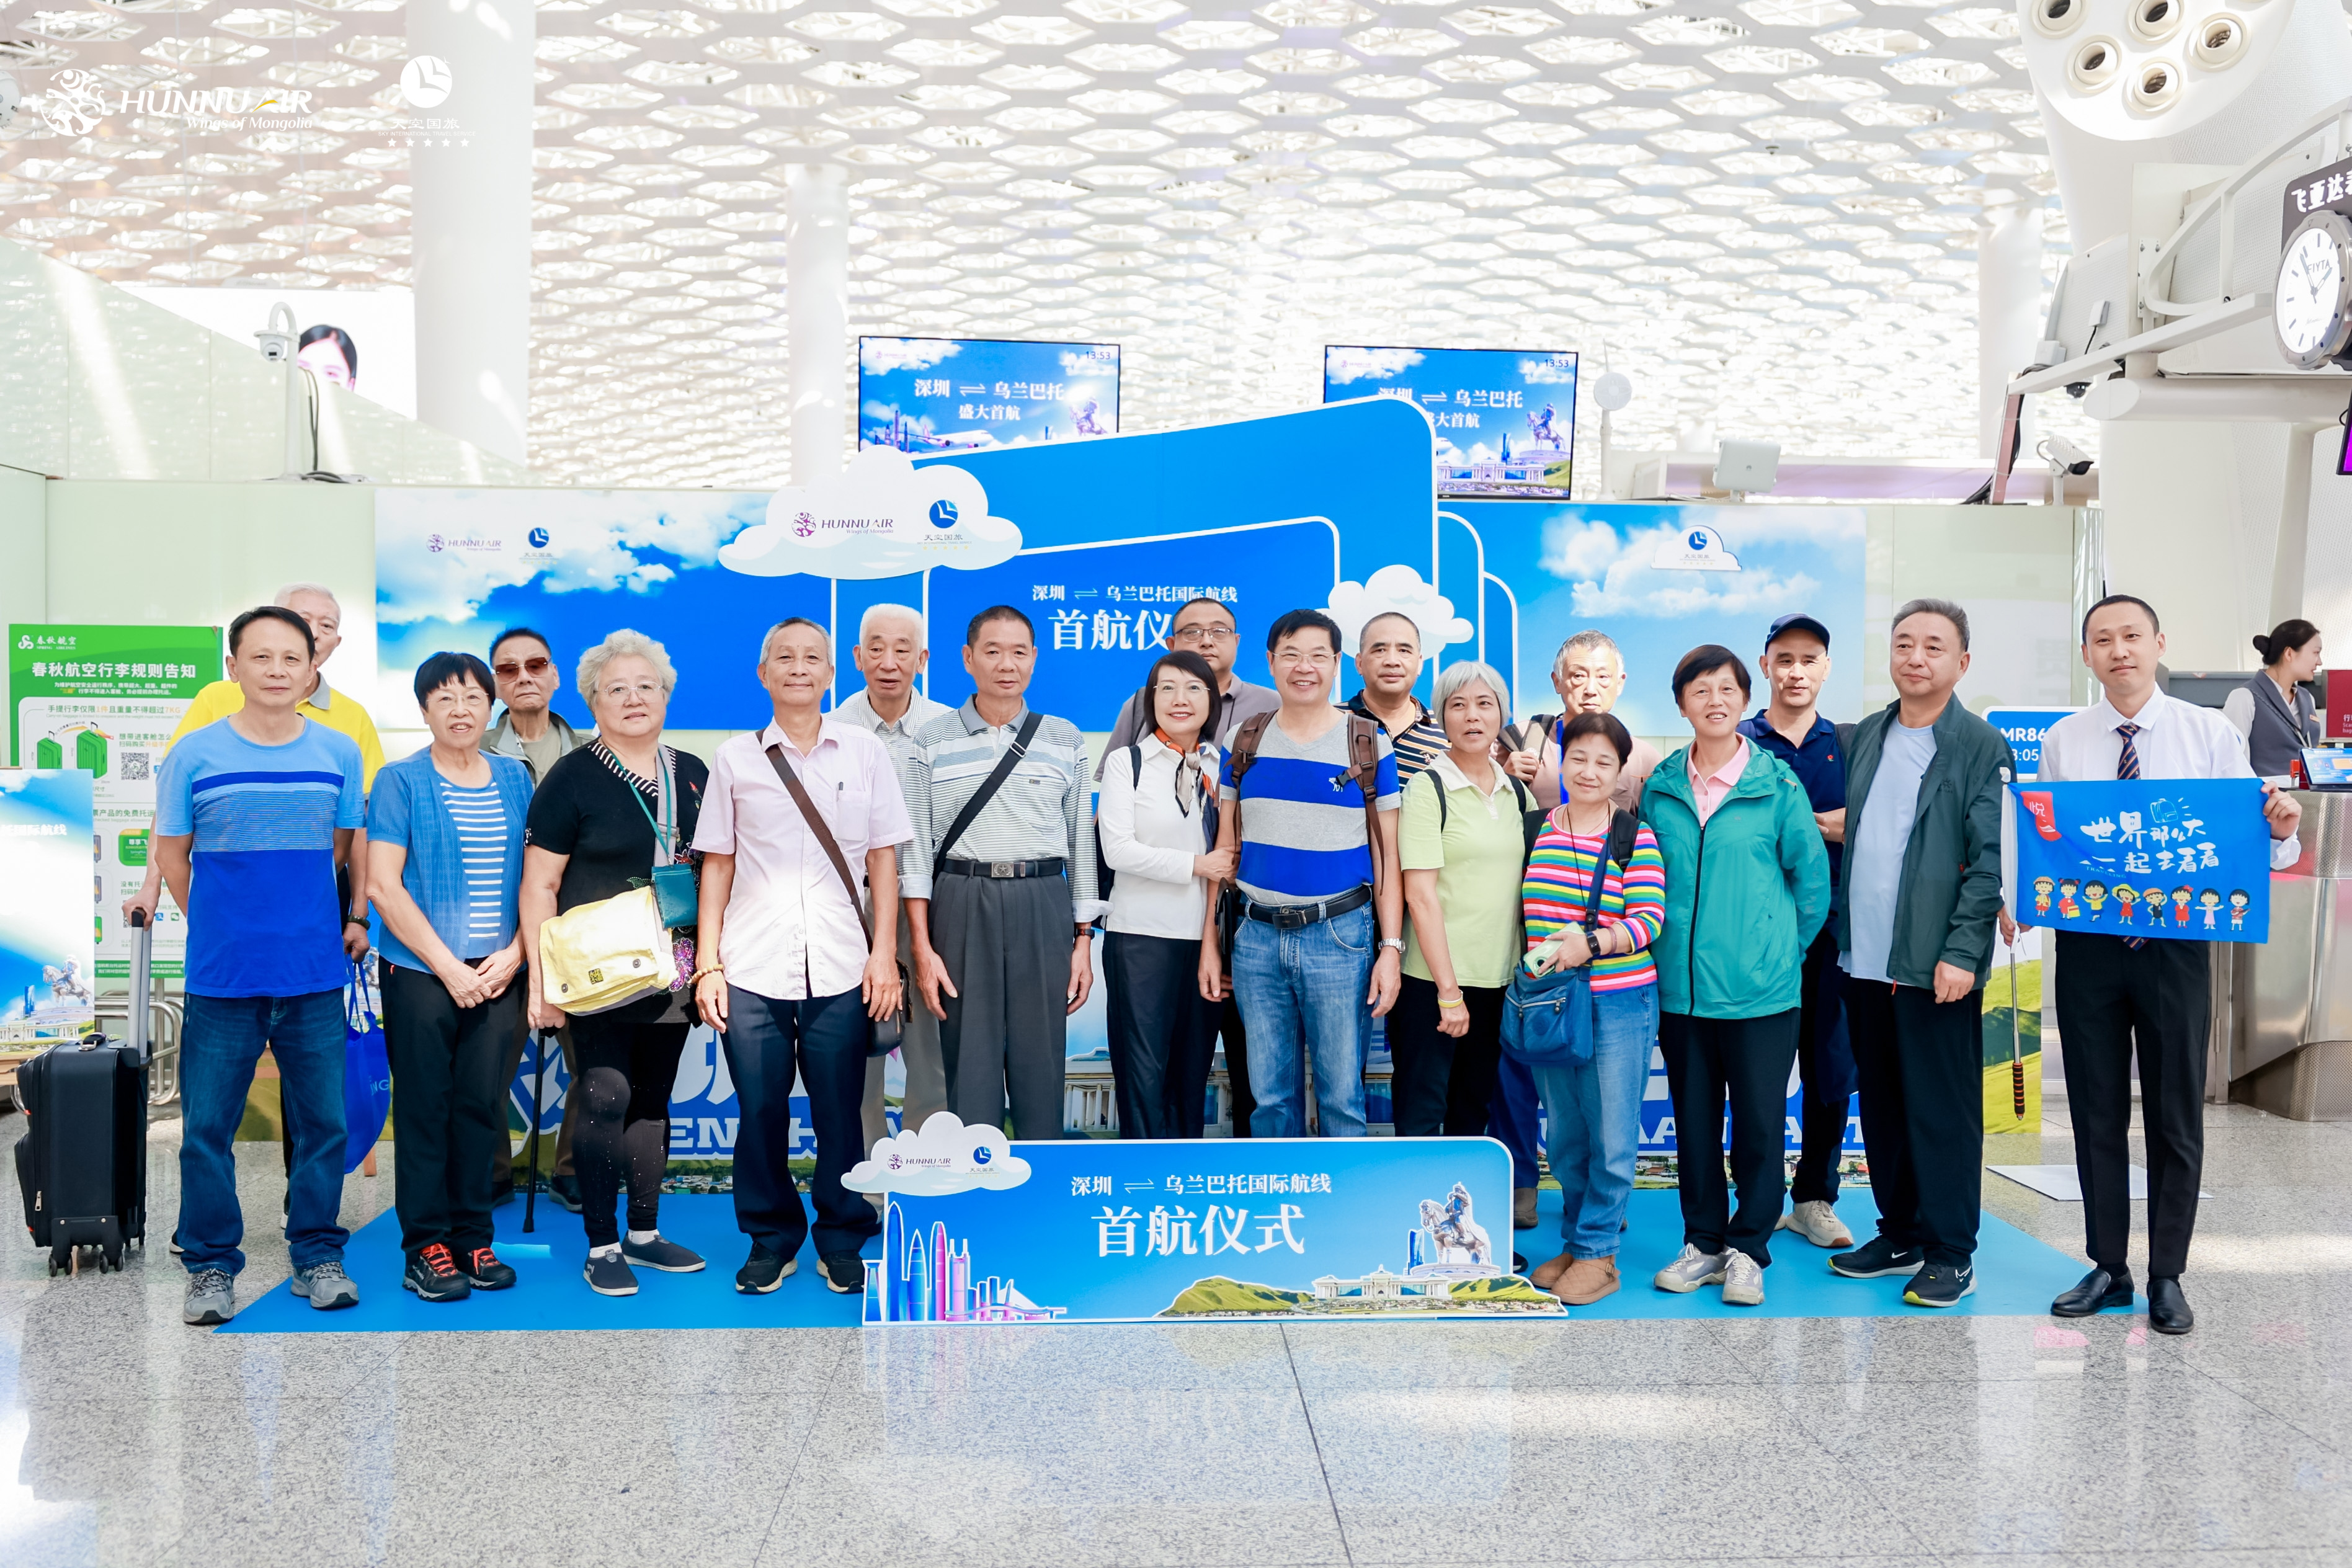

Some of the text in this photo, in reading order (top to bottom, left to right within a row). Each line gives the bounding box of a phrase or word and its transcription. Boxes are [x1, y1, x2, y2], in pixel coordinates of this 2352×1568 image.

[2307, 259, 2330, 273] FIYTA
[1085, 350, 1111, 360] 13:53
[1544, 359, 1569, 368] 13:53
[914, 378, 1064, 401] 深圳 乌兰巴托
[1454, 390, 1523, 409] 乌兰巴托
[959, 404, 1020, 421] 盛大首航
[821, 519, 893, 528] HUNNU AIR
[1032, 585, 1238, 603] 深圳 乌兰巴托国际航线
[37, 635, 77, 645] 春秋航空
[32, 662, 196, 678] 春秋航空行李规则告知
[2080, 811, 2207, 849] 世界那么大
[2091, 842, 2220, 874] 一起去看看
[1071, 1174, 1332, 1196] 深圳 乌兰巴托国际航线
[1090, 1203, 1306, 1257] 首航仪式
